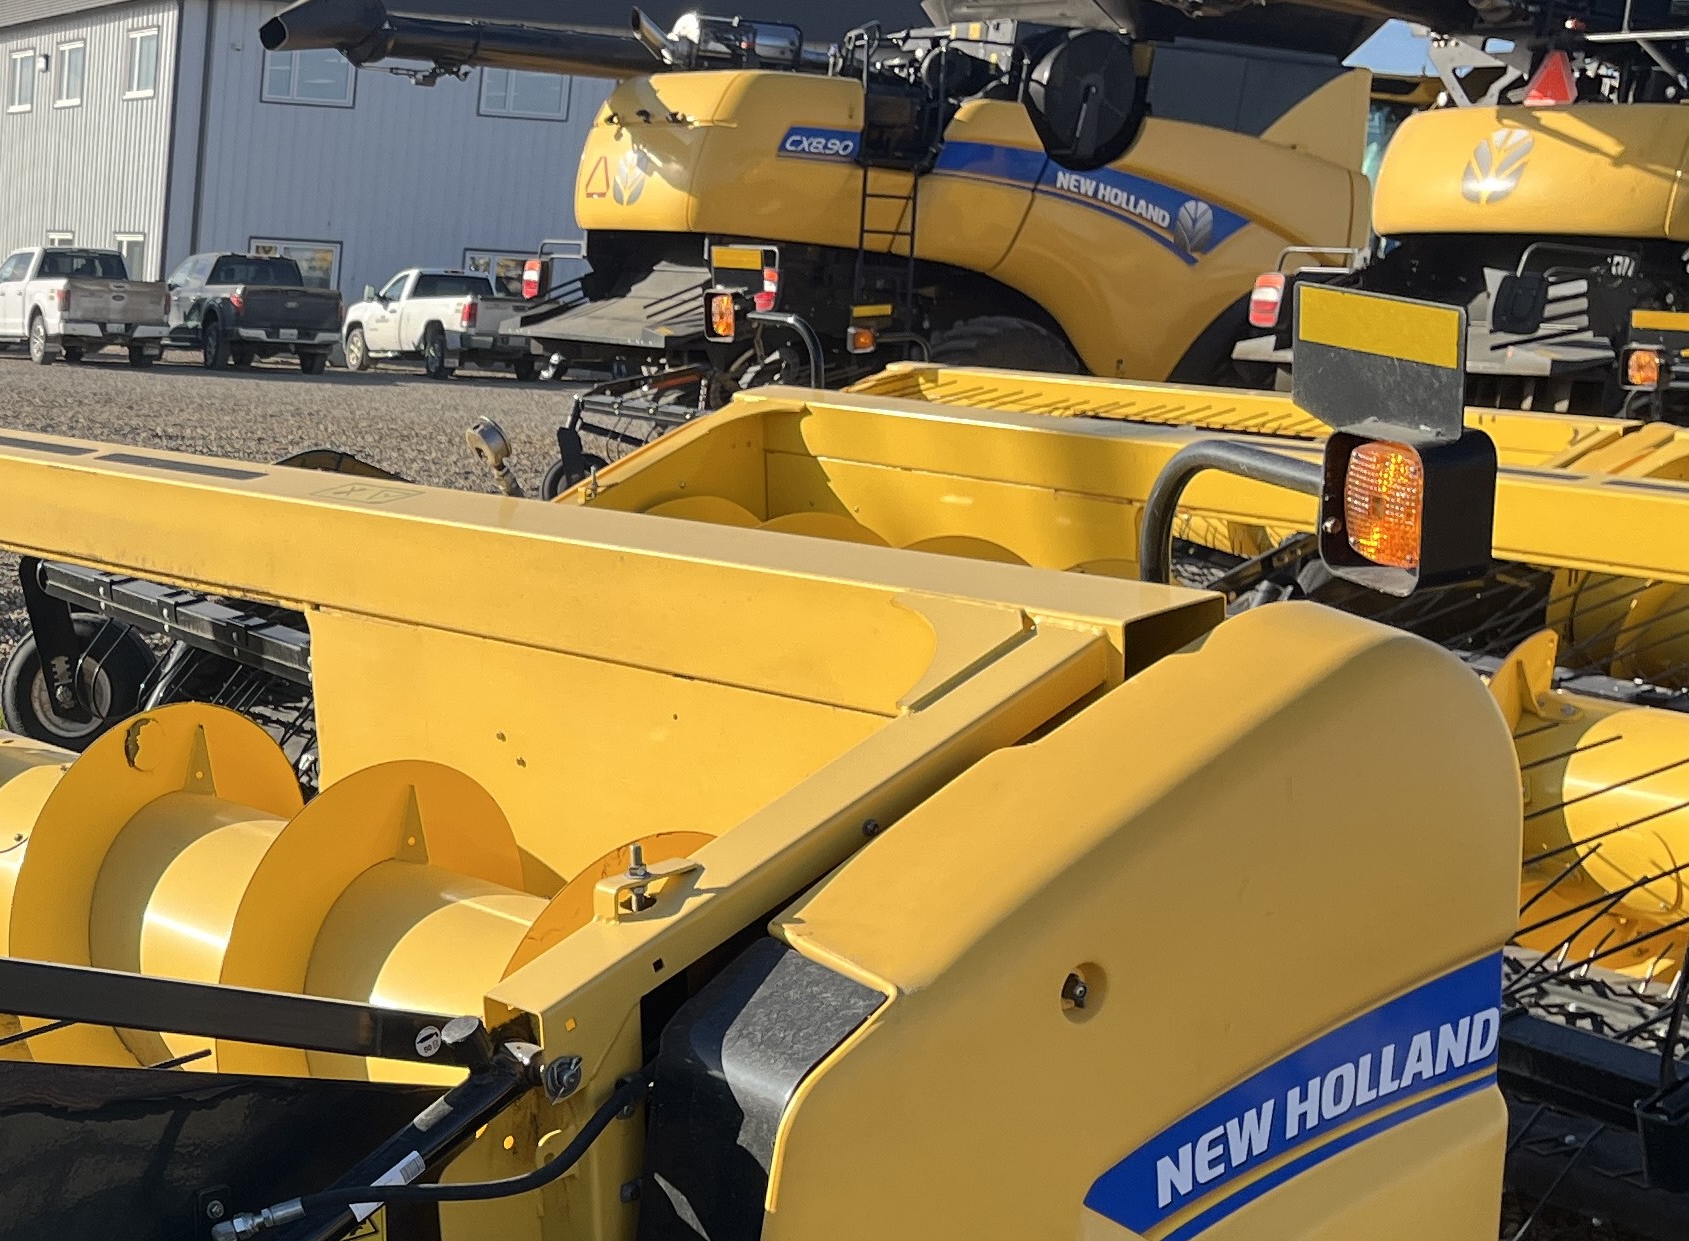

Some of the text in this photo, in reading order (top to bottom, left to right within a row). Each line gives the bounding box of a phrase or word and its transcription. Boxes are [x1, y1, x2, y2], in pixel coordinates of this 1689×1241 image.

[785, 135, 854, 156] CX8.90
[1055, 170, 1171, 228] NEW HOLLAND
[1156, 1006, 1500, 1209] NEW HOLLAND
